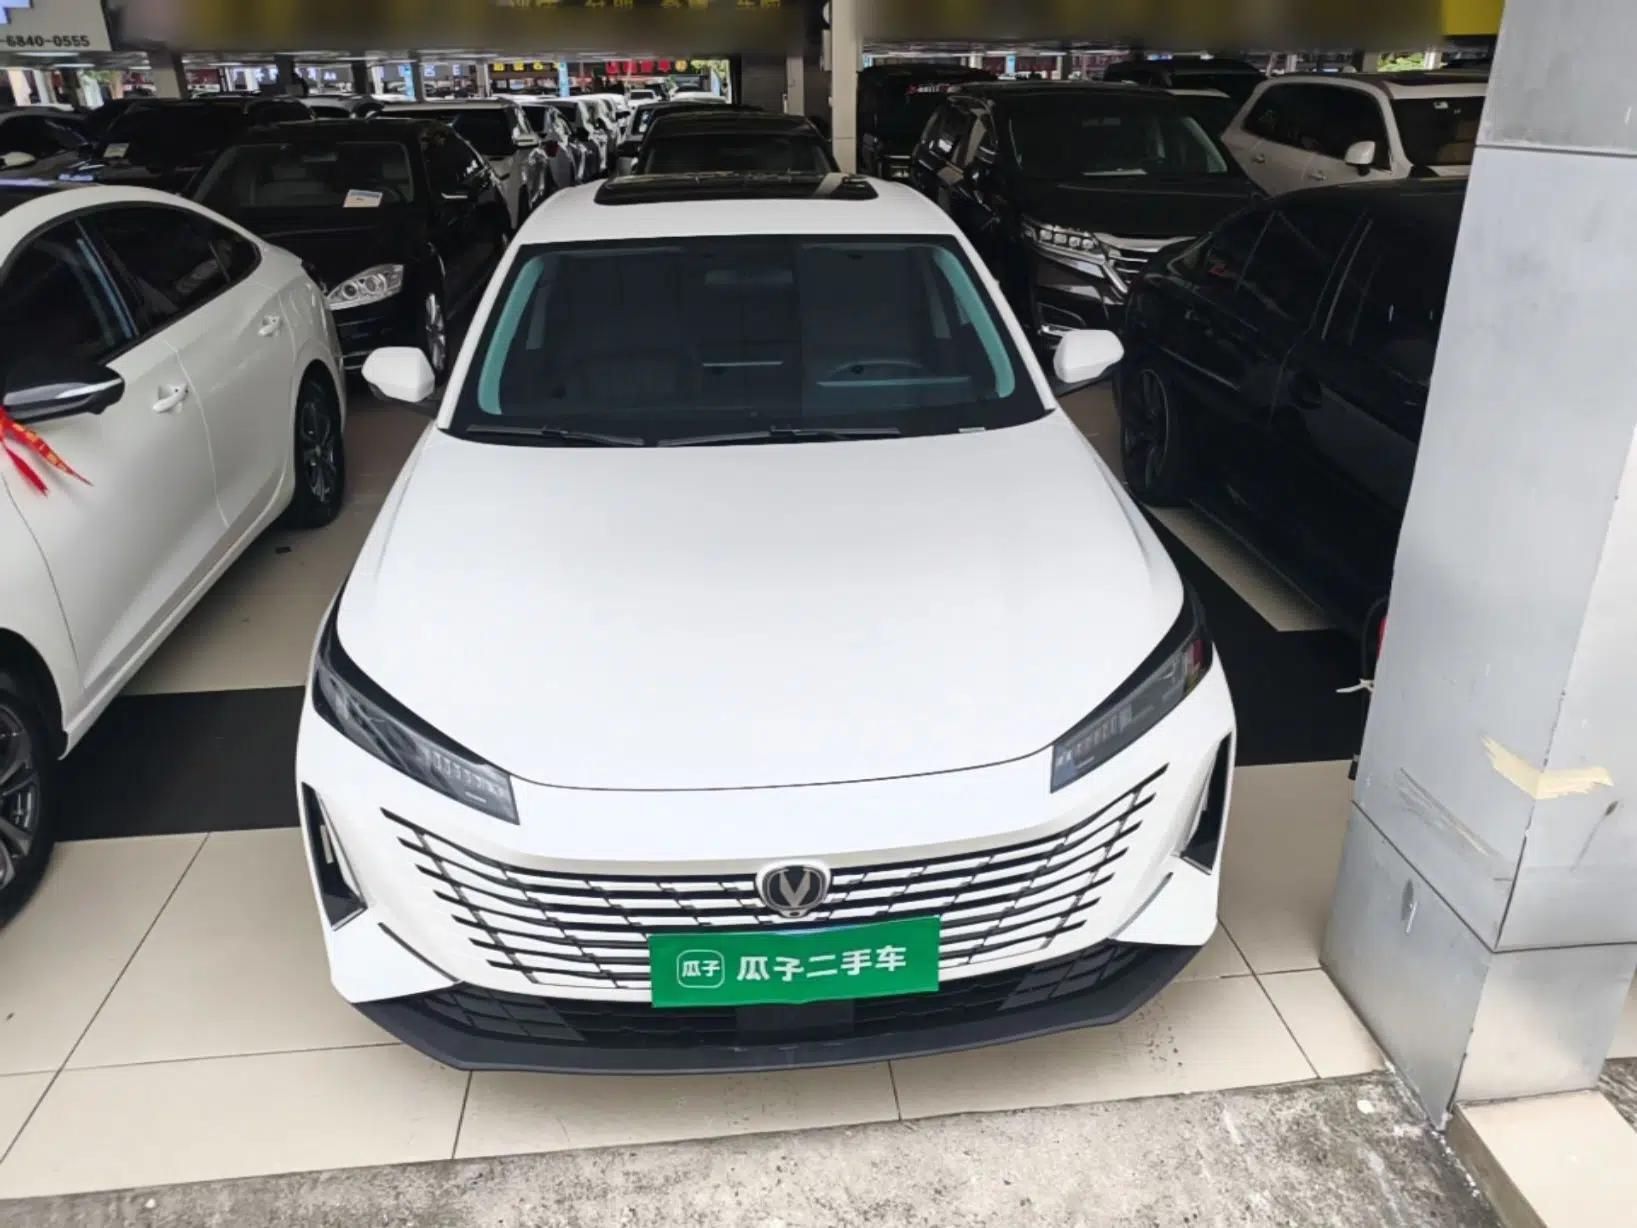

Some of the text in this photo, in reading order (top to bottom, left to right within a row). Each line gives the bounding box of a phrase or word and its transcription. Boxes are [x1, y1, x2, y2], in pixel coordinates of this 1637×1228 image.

[682, 945, 906, 981] 瓜子 瓜子二手车
